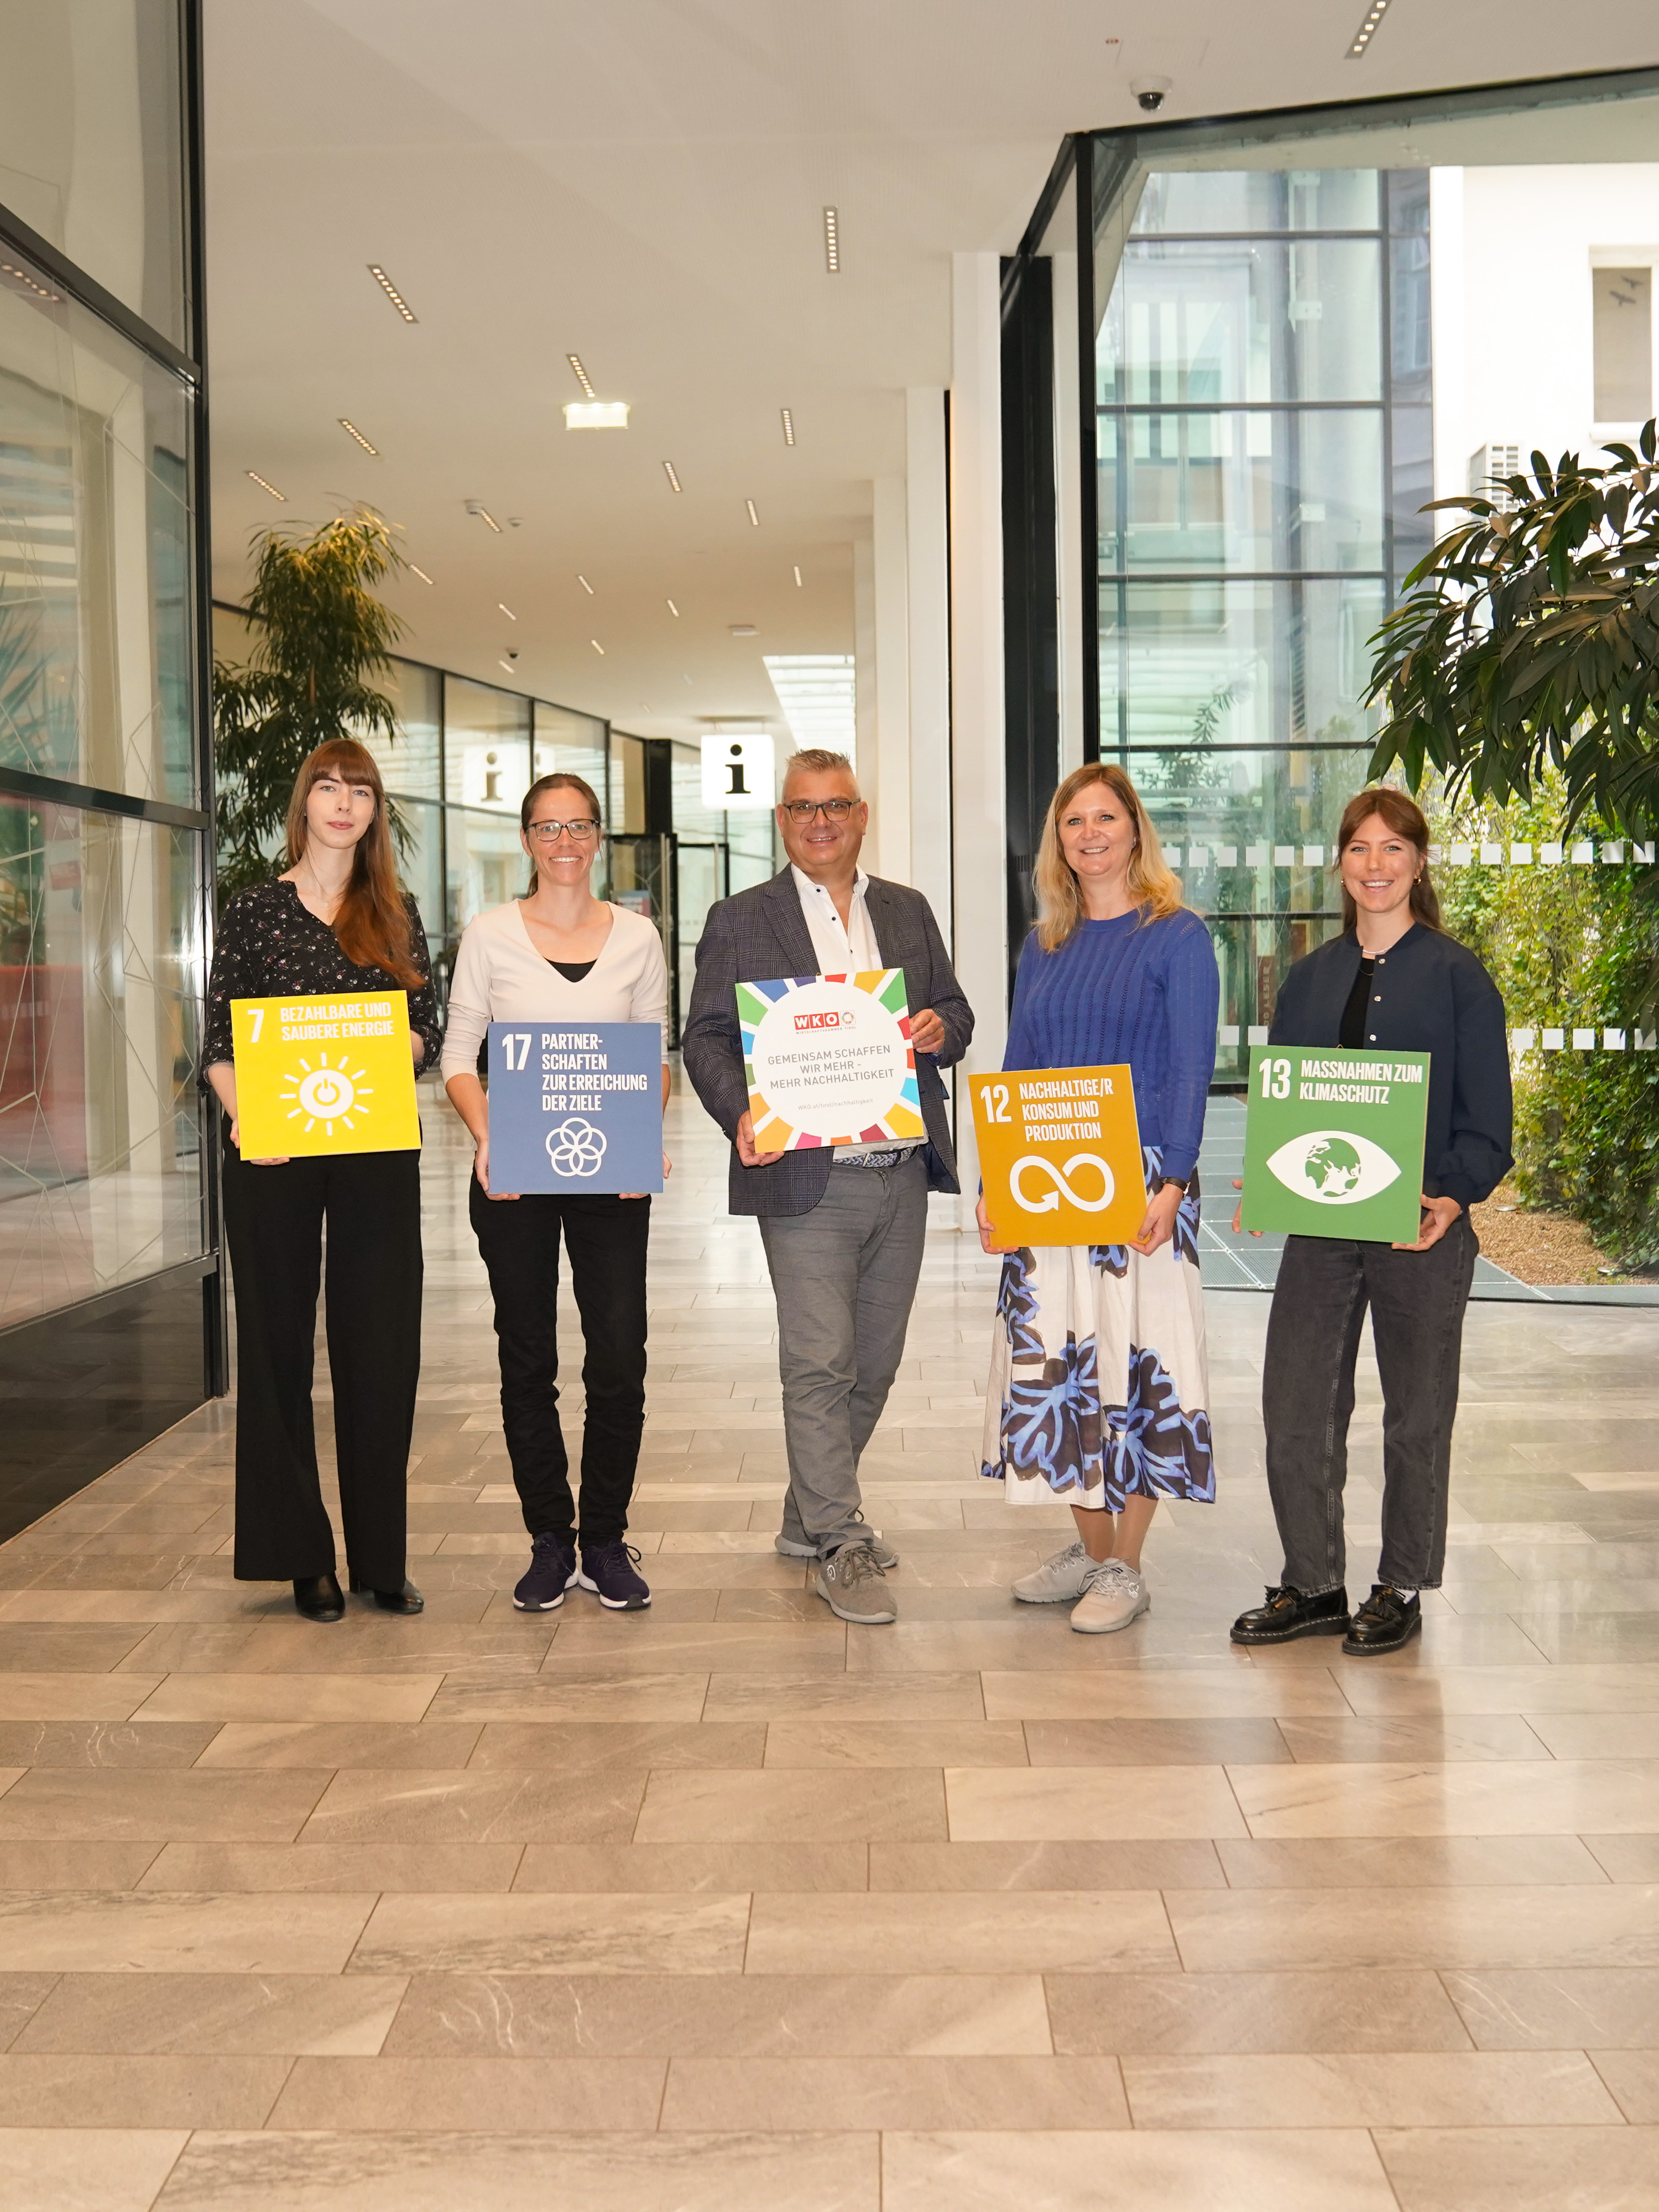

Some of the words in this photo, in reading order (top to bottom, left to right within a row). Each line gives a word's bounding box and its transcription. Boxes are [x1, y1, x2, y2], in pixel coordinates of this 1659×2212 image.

[725, 744, 751, 794] i
[280, 1003, 363, 1022] BEZAHLBARE
[365, 1002, 391, 1018] UND
[795, 1013, 838, 1029] WKO
[247, 1009, 264, 1043] 7
[282, 1022, 340, 1041] SAUBERE
[342, 1021, 394, 1037] ENERGIE
[502, 1034, 532, 1071] 17
[541, 1034, 603, 1050] PARTNER-
[541, 1053, 607, 1070] SCHAFTEN
[768, 1050, 832, 1066] GEMEINSAM
[834, 1045, 890, 1058] SCHAFFEN
[800, 1062, 821, 1074] WIR
[824, 1060, 854, 1072] MEHR
[1301, 1060, 1392, 1082] MASSNAHMEN
[1394, 1065, 1423, 1083] ZUM
[542, 1074, 567, 1091] ZUR
[570, 1074, 648, 1091] ERREICHUNG
[770, 1078, 801, 1089] MEHR
[804, 1068, 894, 1086] NACHHALTIGKEIT
[1019, 1078, 1114, 1100] NACHHALTIGE/R
[1259, 1058, 1291, 1099] 13
[542, 1094, 567, 1111] DER
[569, 1094, 602, 1111] ZIELE
[980, 1084, 1012, 1123] 12
[1299, 1082, 1390, 1104] KLIMASCHUTZ
[798, 1098, 874, 1110] WKO.at/tirol/nachhaltigkeit
[1021, 1102, 1073, 1121] KONSUM
[1073, 1100, 1099, 1118] UND
[1025, 1122, 1102, 1142] PRODUKTION
